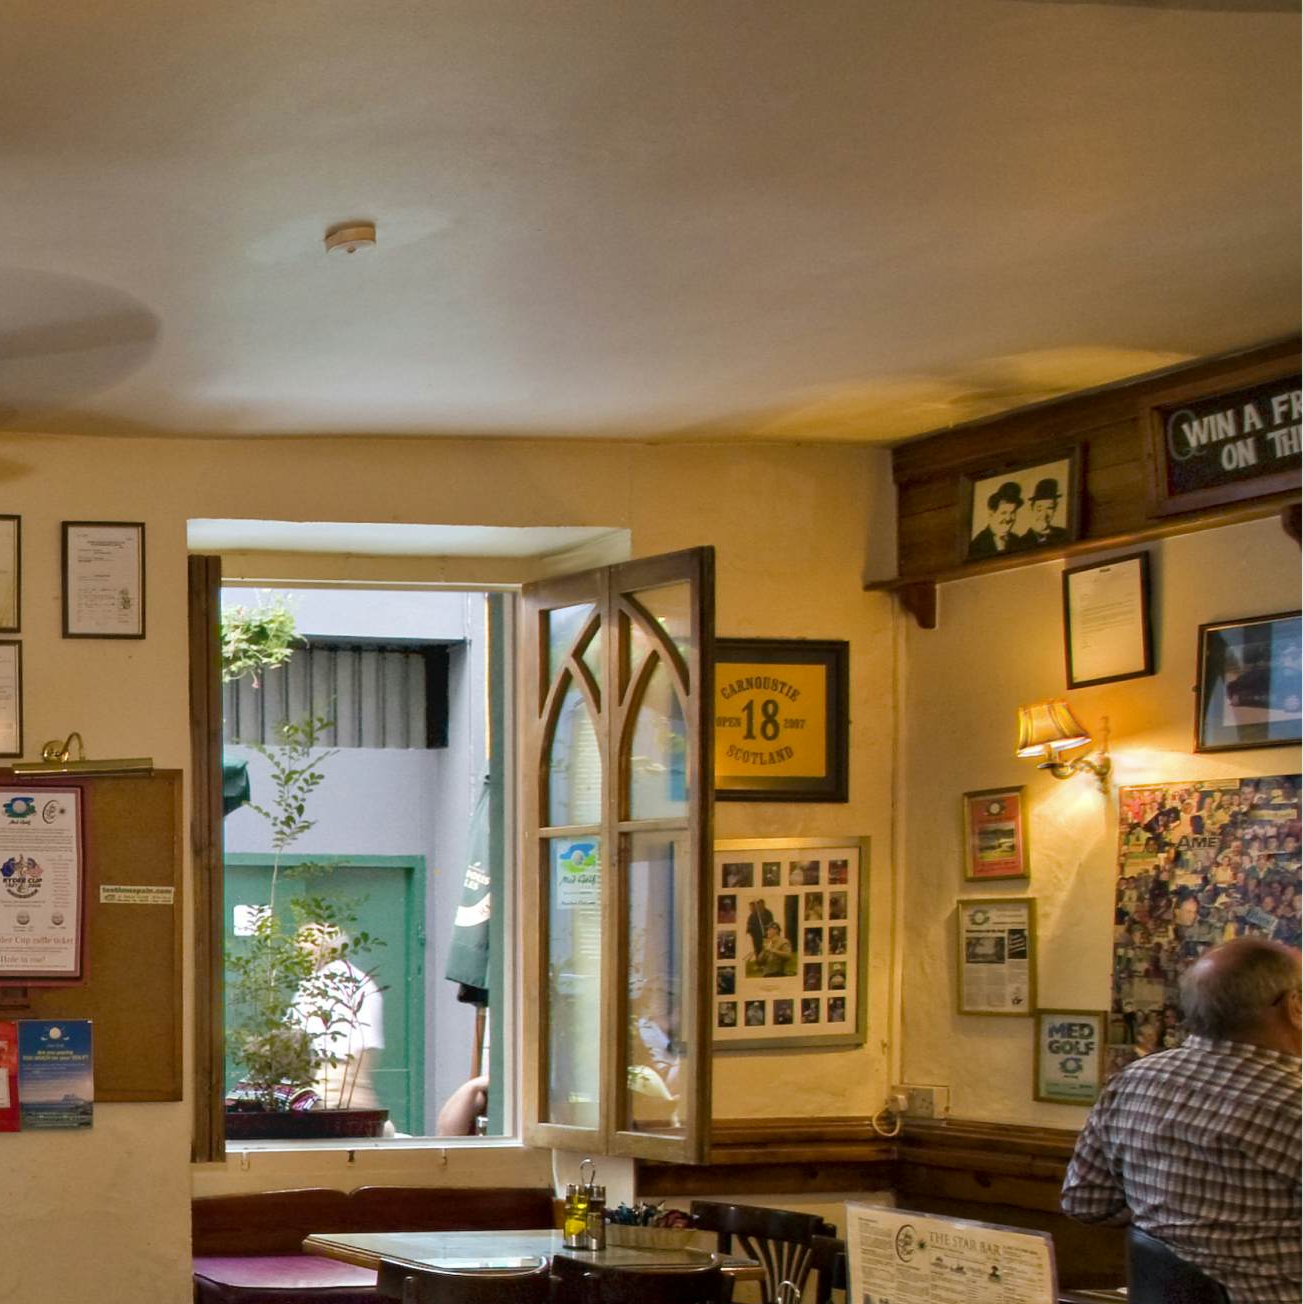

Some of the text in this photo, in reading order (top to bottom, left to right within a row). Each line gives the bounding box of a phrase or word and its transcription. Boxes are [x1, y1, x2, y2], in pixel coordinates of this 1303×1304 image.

[1182, 409, 1236, 449] WIN
[1244, 405, 1264, 433] A
[1221, 425, 1302, 472] ON TH
[720, 676, 801, 702] CARNOUSTIE
[715, 716, 741, 728] OPEN
[742, 699, 780, 741] 18
[726, 744, 794, 765] SCOTLAND
[1048, 1022, 1094, 1039] MED
[1048, 1040, 1095, 1056] GOLF
[929, 1231, 1001, 1256] THE STAR BAR
